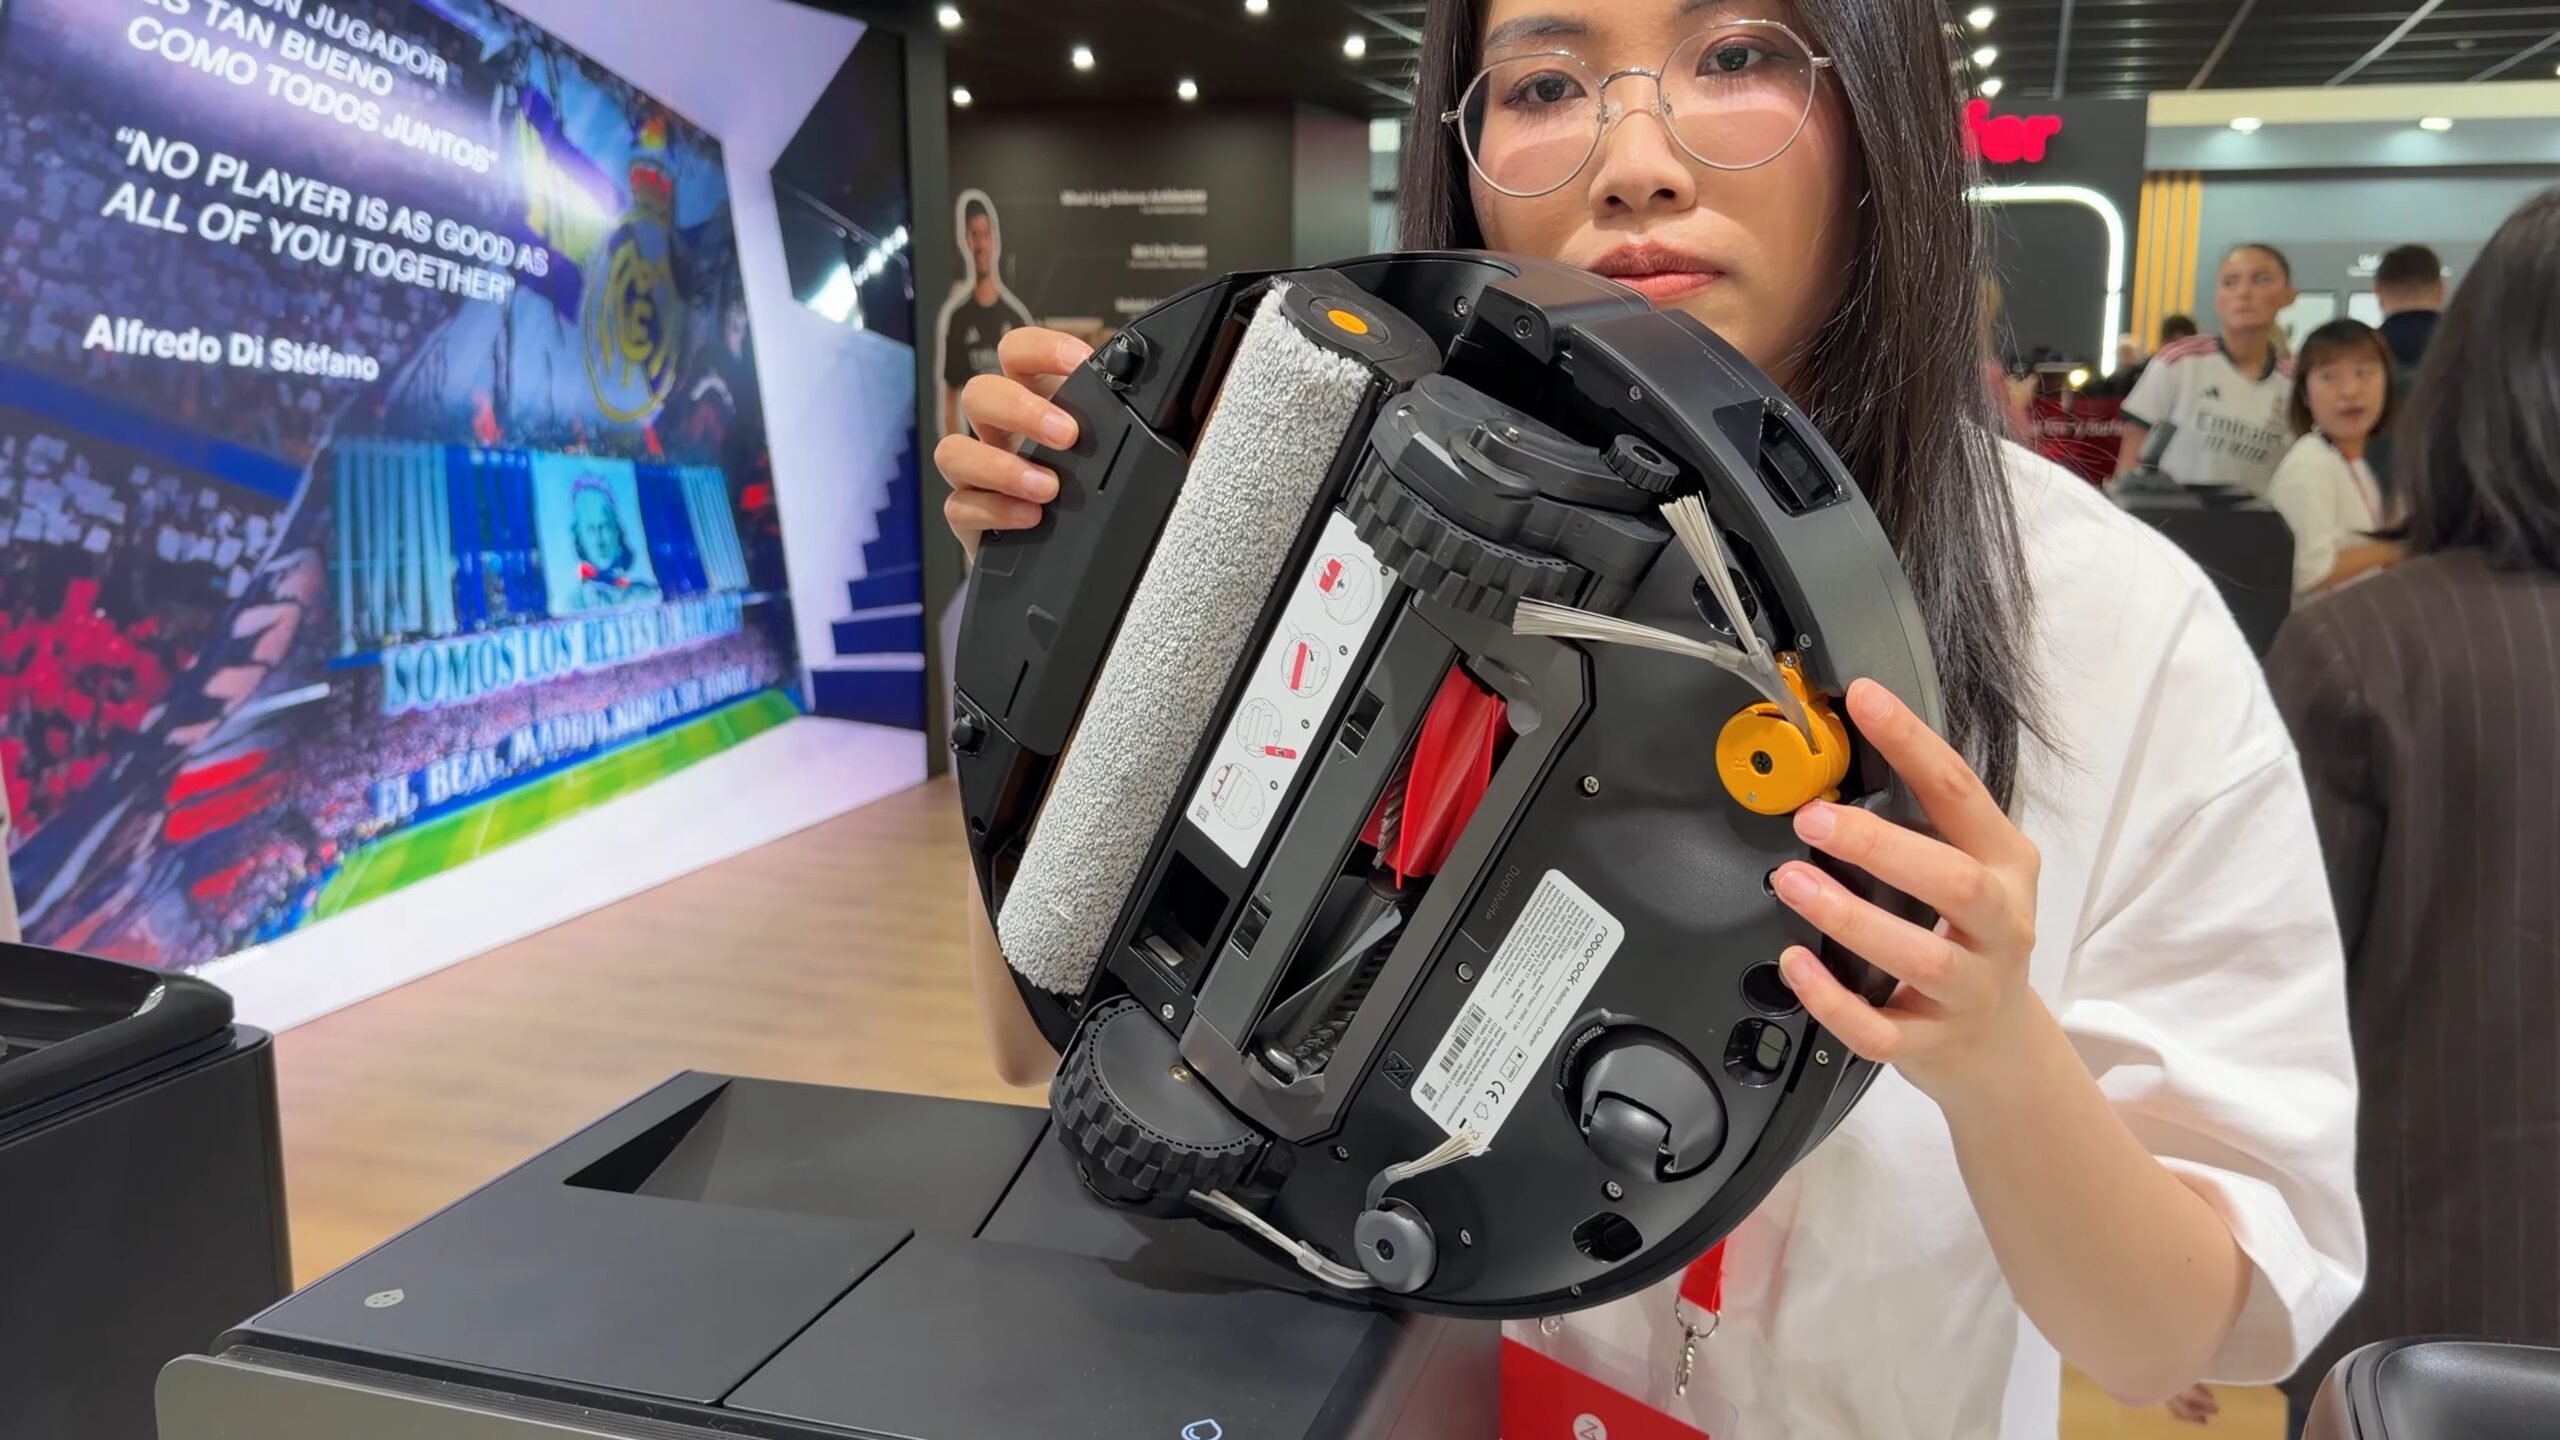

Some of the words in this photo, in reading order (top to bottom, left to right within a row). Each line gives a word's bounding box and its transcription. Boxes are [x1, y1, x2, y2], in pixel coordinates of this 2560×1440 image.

[127, 16, 258, 85] COMO
[266, 63, 380, 132] TODOS
[204, 0, 276, 49] TAN
[279, 27, 394, 96] BUENO
[305, 4, 448, 85] JUGADOR
[101, 182, 188, 234] ALL
[198, 202, 262, 245] OF
[268, 216, 347, 267] YOU
[205, 152, 352, 222] PLAYER
[355, 194, 389, 231] IS
[388, 206, 433, 243] AS
[435, 218, 515, 266] GOOD
[514, 243, 549, 277] AS
[82, 314, 222, 363] Alfredo
[228, 332, 264, 369] Di
[270, 338, 379, 382] Stéfano
[393, 633, 517, 702] SOMOS
[518, 623, 574, 678] LOS
[374, 776, 419, 823] EL
[425, 748, 505, 807] REAL
[509, 711, 609, 766] MADRID
[1567, 925, 1608, 986] roborock
[1540, 1005, 1557, 1028] Vacuum
[1553, 985, 1570, 1007] Robotic
[1527, 1025, 1544, 1048] Cleaner
